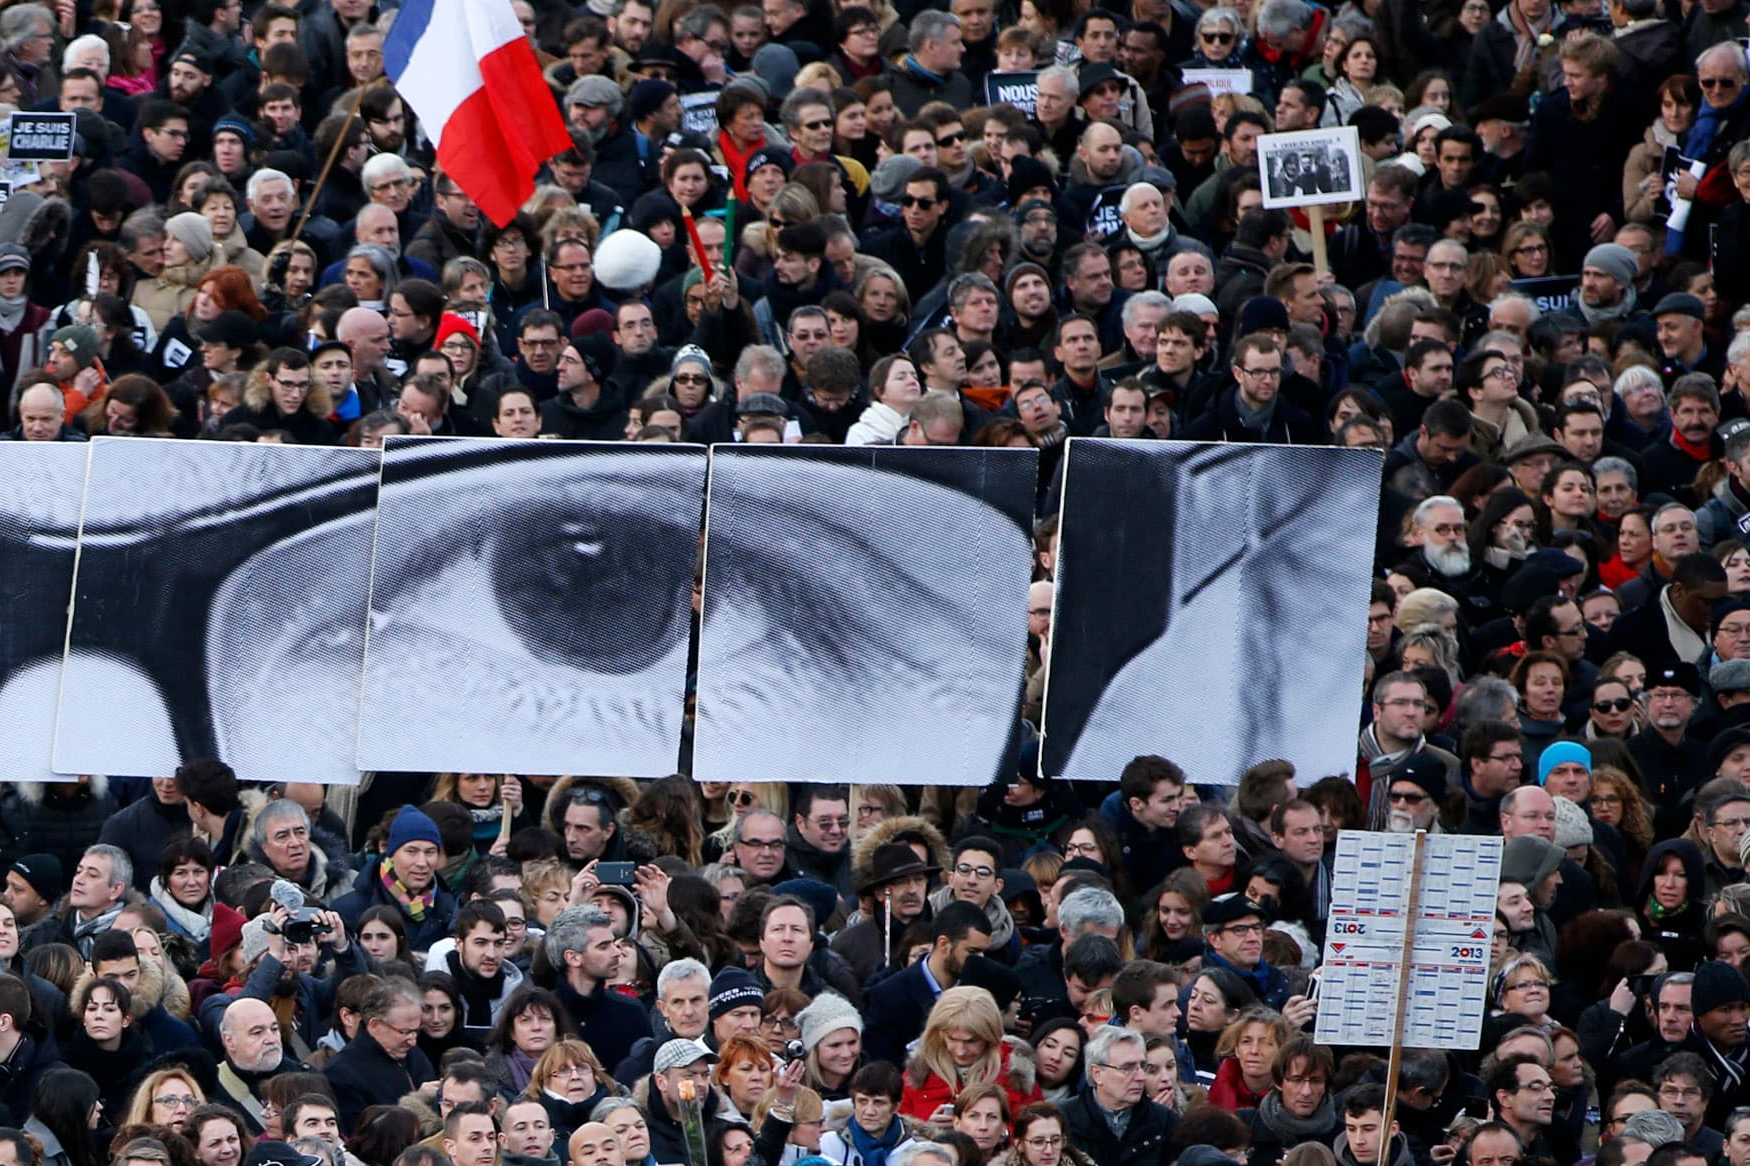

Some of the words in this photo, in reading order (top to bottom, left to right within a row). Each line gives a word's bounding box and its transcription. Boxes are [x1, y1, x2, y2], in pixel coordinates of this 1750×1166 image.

[999, 84, 1038, 103] NOUS
[14, 121, 36, 133] JE
[36, 121, 71, 134] SUIS
[13, 134, 70, 150] CHARLIE
[1094, 206, 1117, 222] JE
[1536, 295, 1570, 313] SUI
[1450, 946, 1484, 960] 2013
